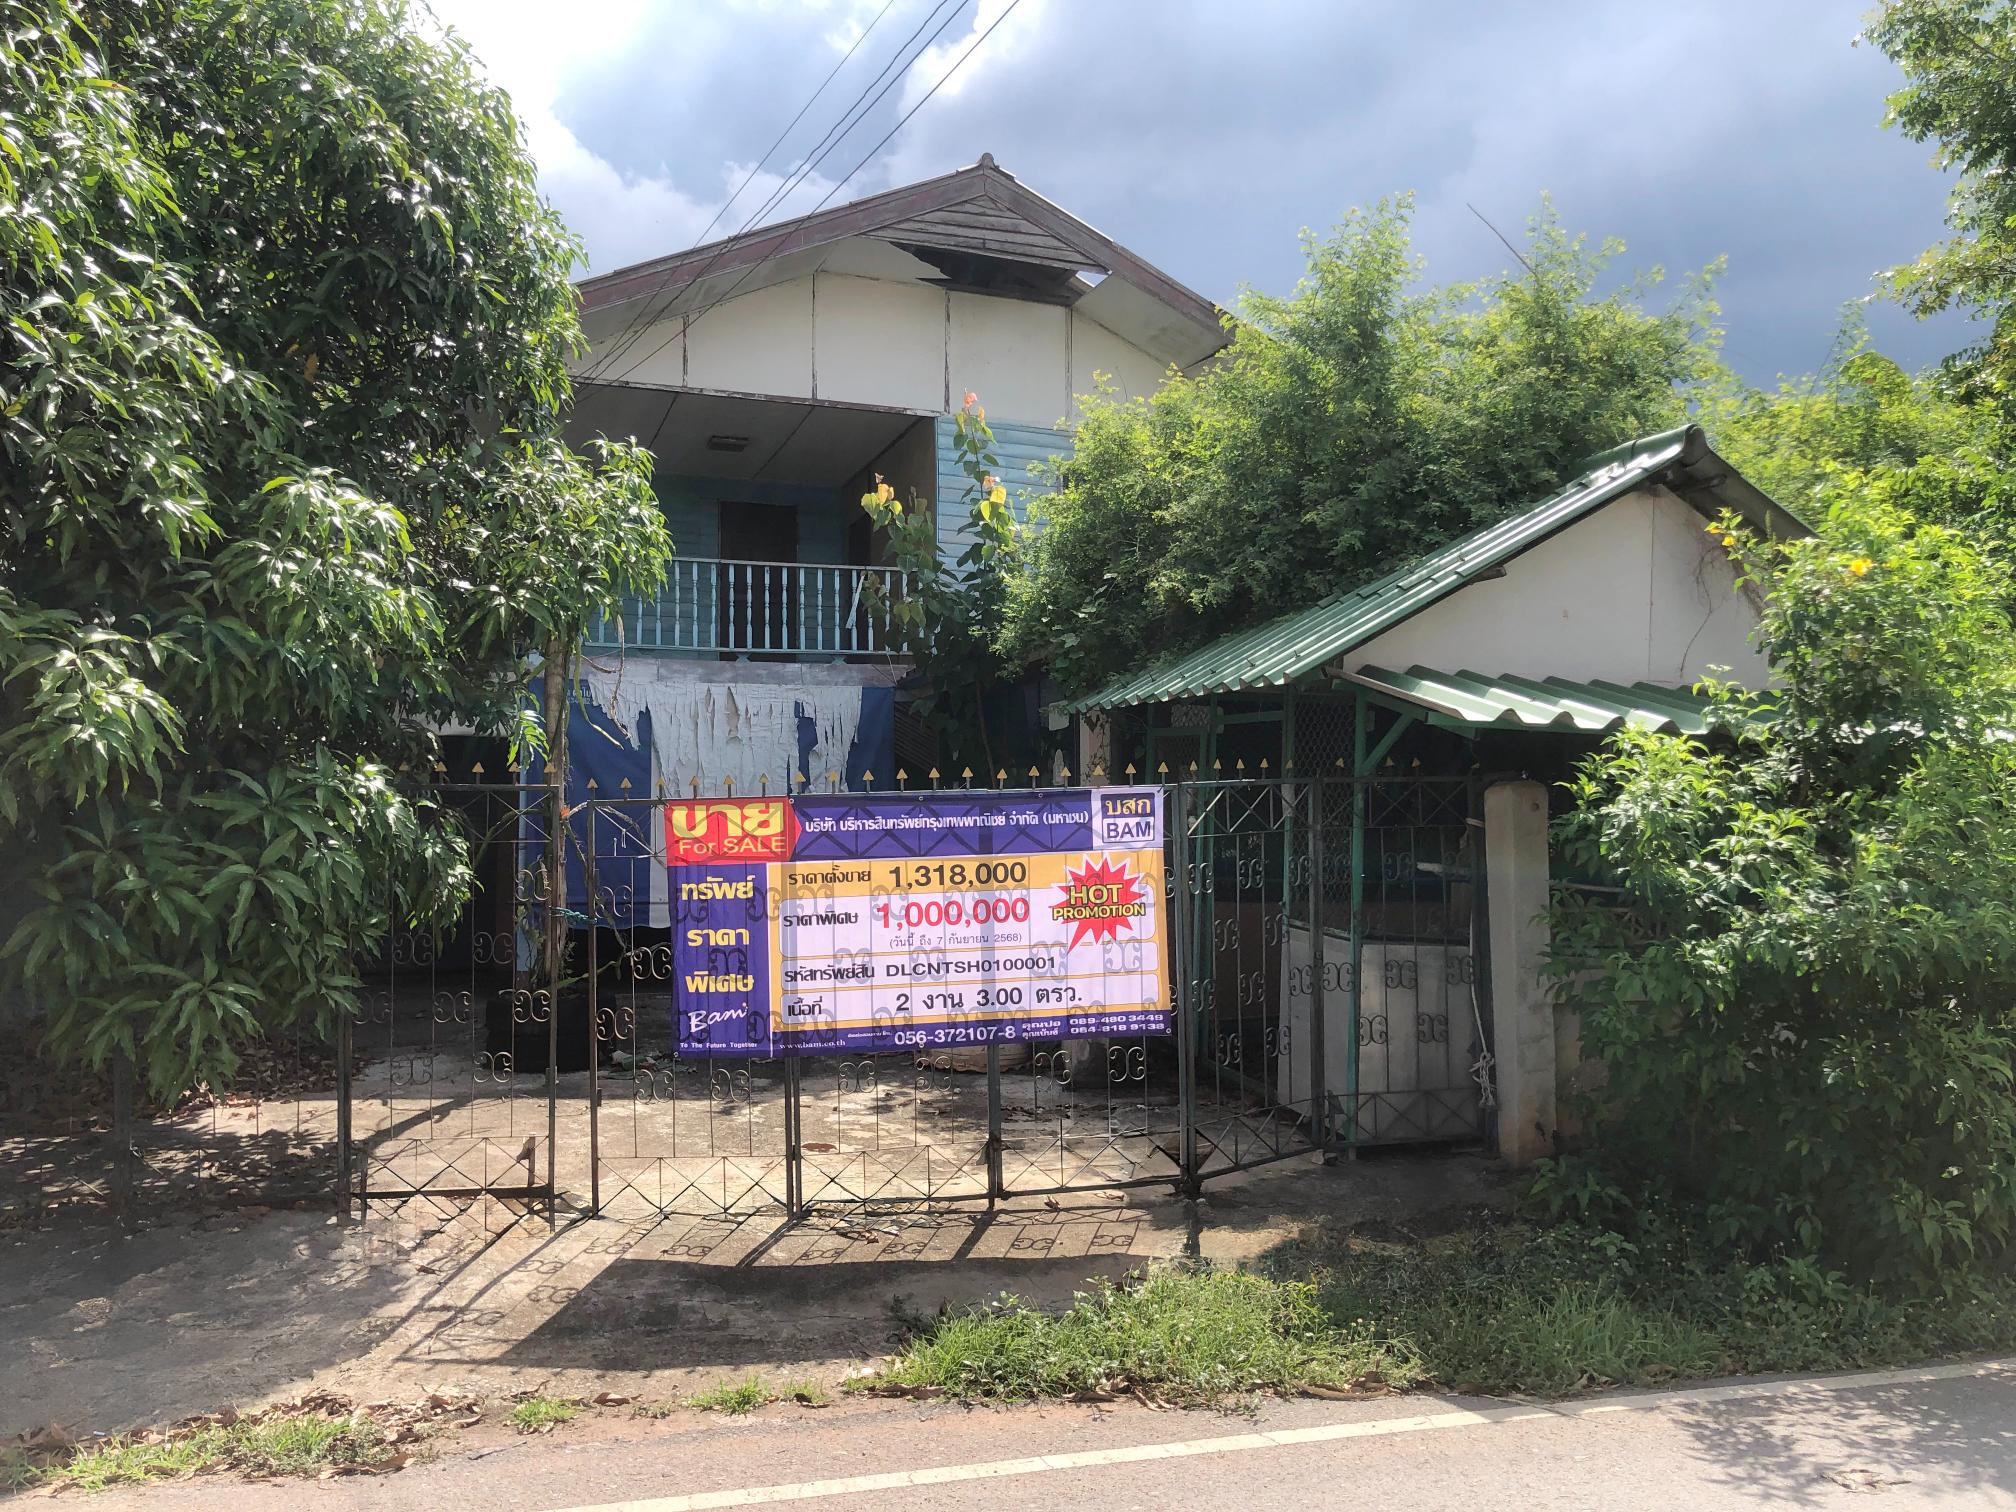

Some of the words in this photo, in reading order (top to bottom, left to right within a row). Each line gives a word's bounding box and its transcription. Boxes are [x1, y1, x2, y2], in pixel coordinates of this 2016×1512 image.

[1105, 799, 1151, 816] บสก
[805, 816, 837, 833] บริษัท
[1009, 811, 1039, 826] จำกัด
[1042, 810, 1089, 826] (มหาชน)
[1106, 821, 1151, 839] BAM
[679, 840, 719, 855] For
[723, 836, 787, 853] SALE
[788, 865, 871, 885] ราคาตั้งขาย
[889, 861, 1027, 890] 1,318,000
[681, 875, 755, 900] ทรัพย์
[1068, 884, 1123, 905] HOT
[783, 910, 859, 927] ราคาพิเศษ
[876, 897, 1030, 931] 1,000,000
[1053, 903, 1146, 920] PROMOTION
[687, 928, 750, 947] ราคา
[889, 932, 915, 949] (วันนี้
[919, 934, 932, 946] ถึง
[937, 936, 943, 945] 7
[948, 932, 989, 944] กันยายน
[994, 933, 1022, 943] 2568)
[784, 963, 875, 983] รหัสทรัพย์สิน
[886, 956, 1056, 977] DLCNTSH0100001
[685, 971, 755, 993] พิเศษ
[787, 996, 823, 1017] เนื้อที่
[896, 993, 910, 1012] 2
[922, 991, 964, 1010] งาน
[976, 987, 1023, 1007] 3.00
[779, 1039, 846, 1050] www.bam.co.th
[894, 1026, 1017, 1046] 056-372107-8
